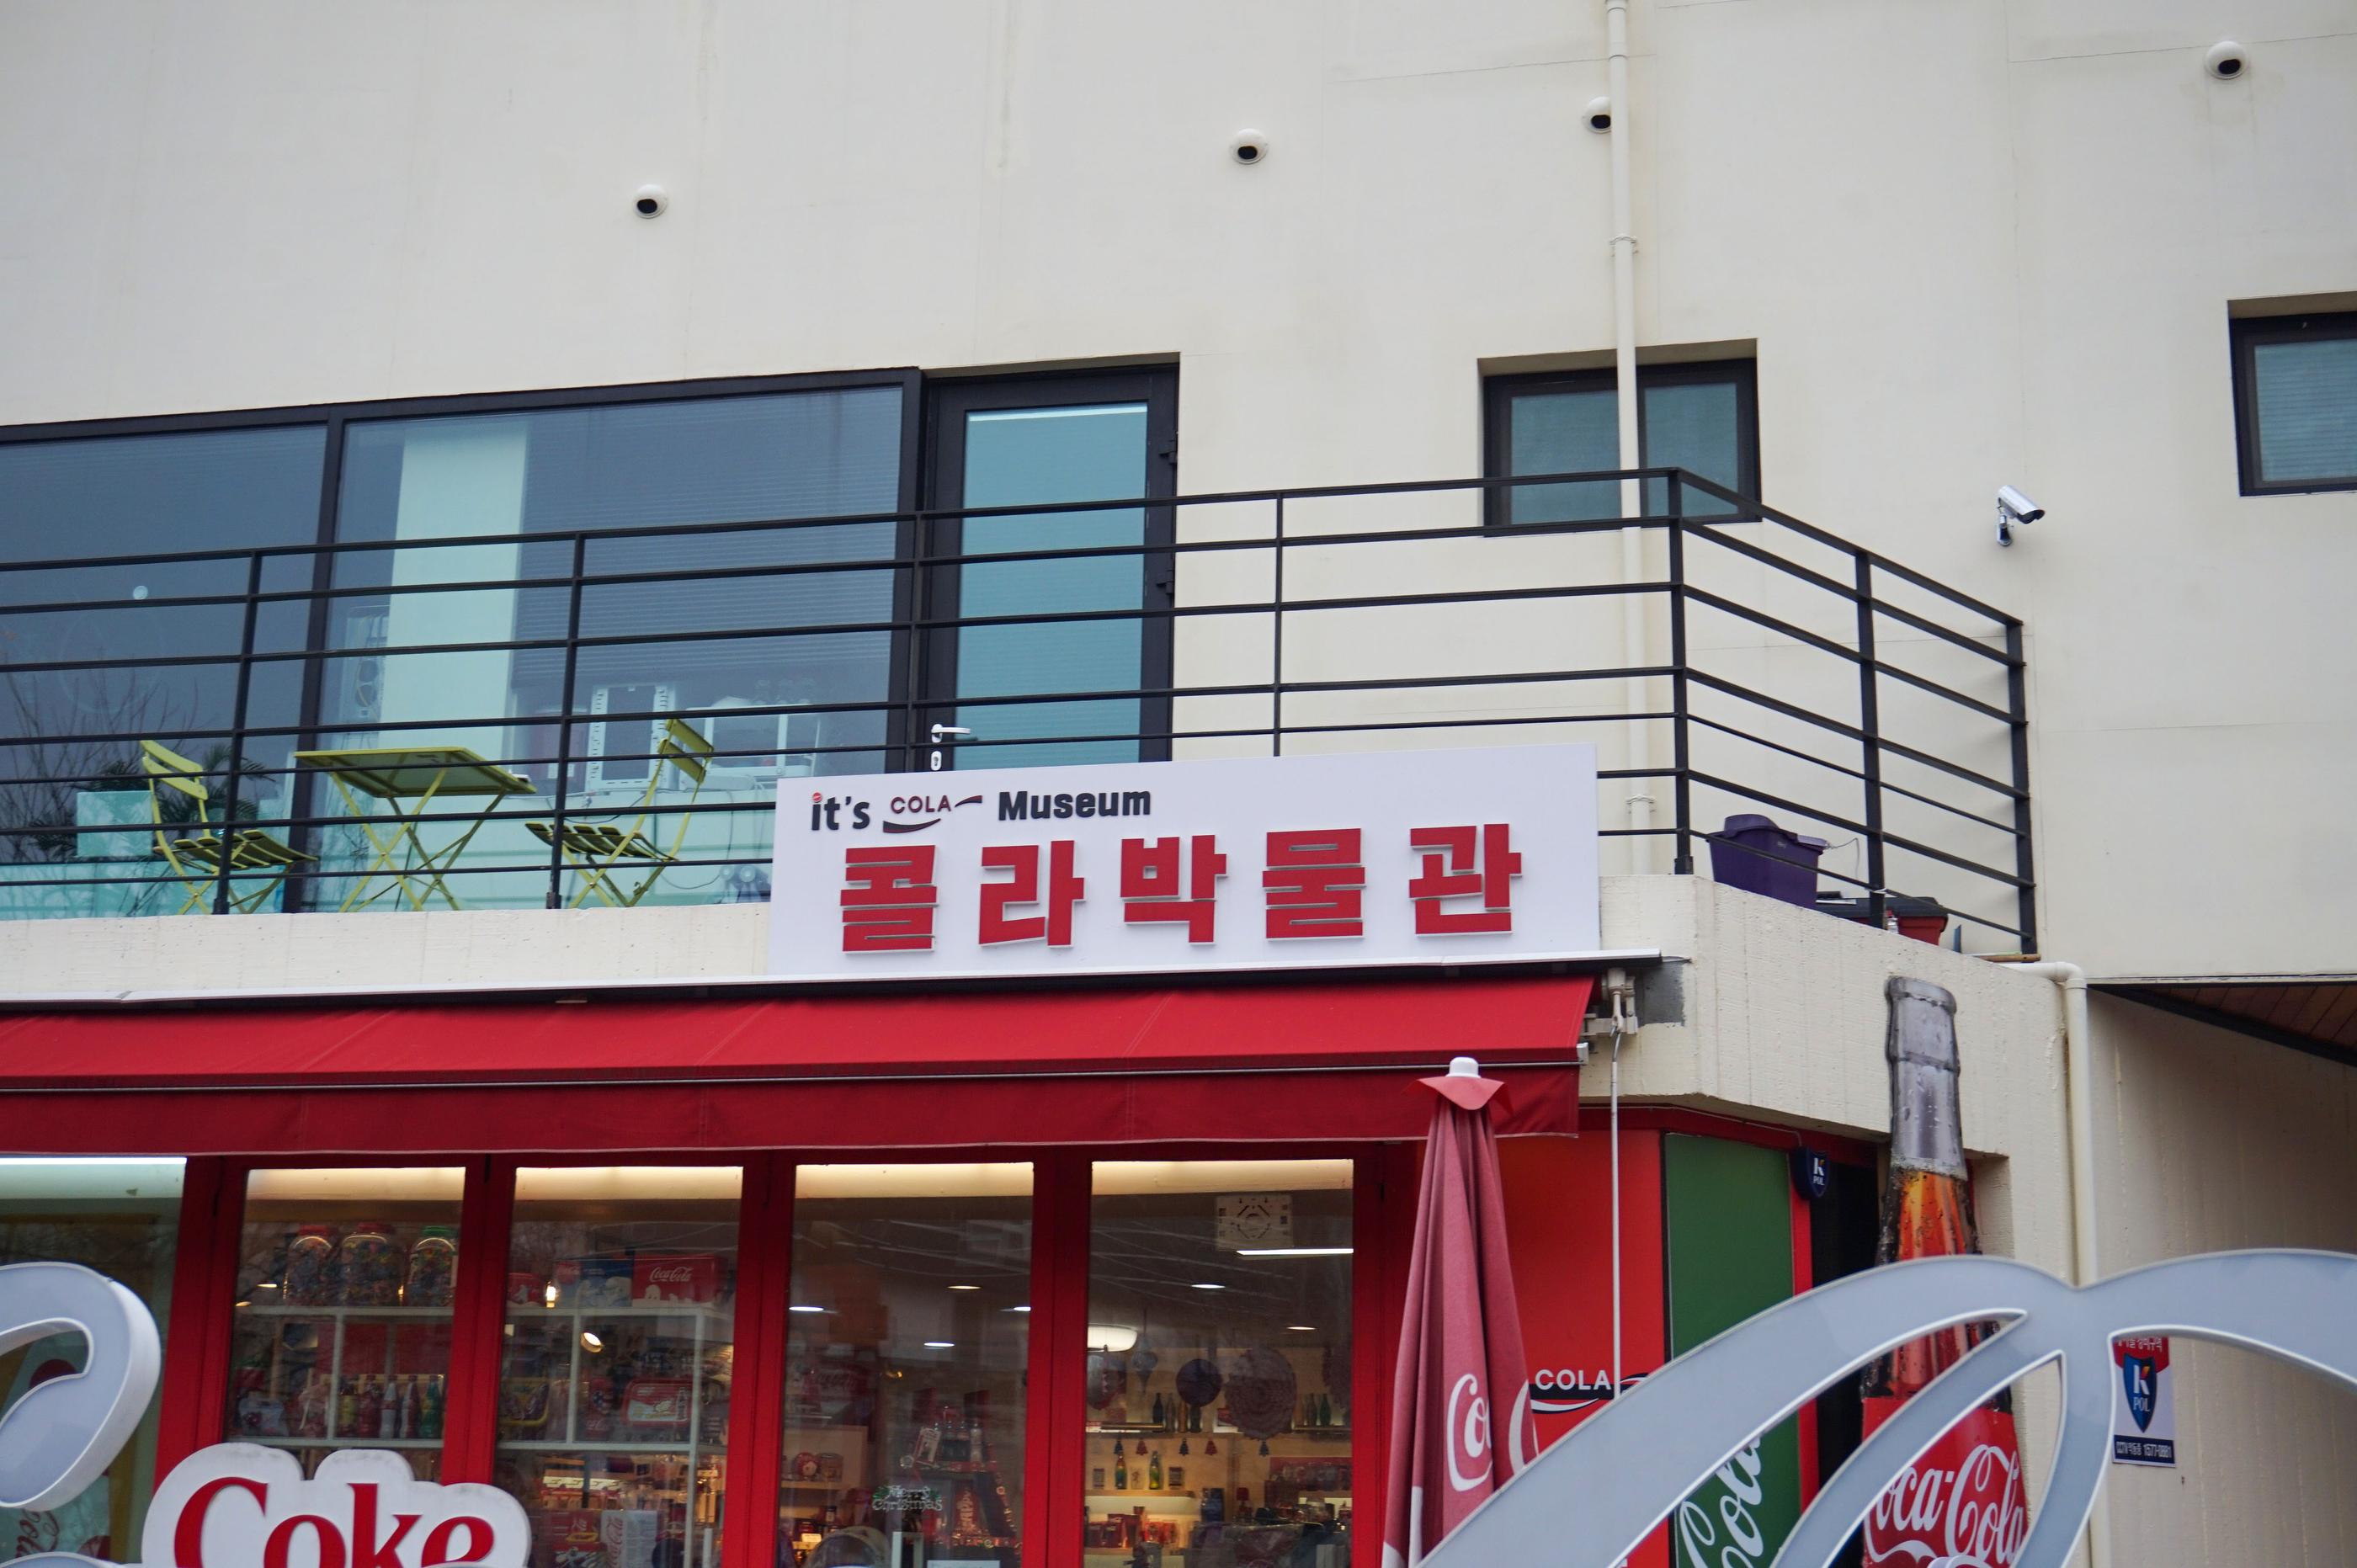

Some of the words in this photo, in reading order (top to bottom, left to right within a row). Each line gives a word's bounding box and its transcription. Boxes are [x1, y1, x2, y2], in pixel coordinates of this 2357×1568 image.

[811, 792, 870, 832] it's
[891, 795, 951, 814] COLA
[998, 790, 1152, 821] Museum
[839, 822, 1523, 954] 콜라박물관
[1535, 1369, 1612, 1391] COLA
[2132, 1396, 2151, 1412] POL
[174, 1476, 494, 1568] Coke
